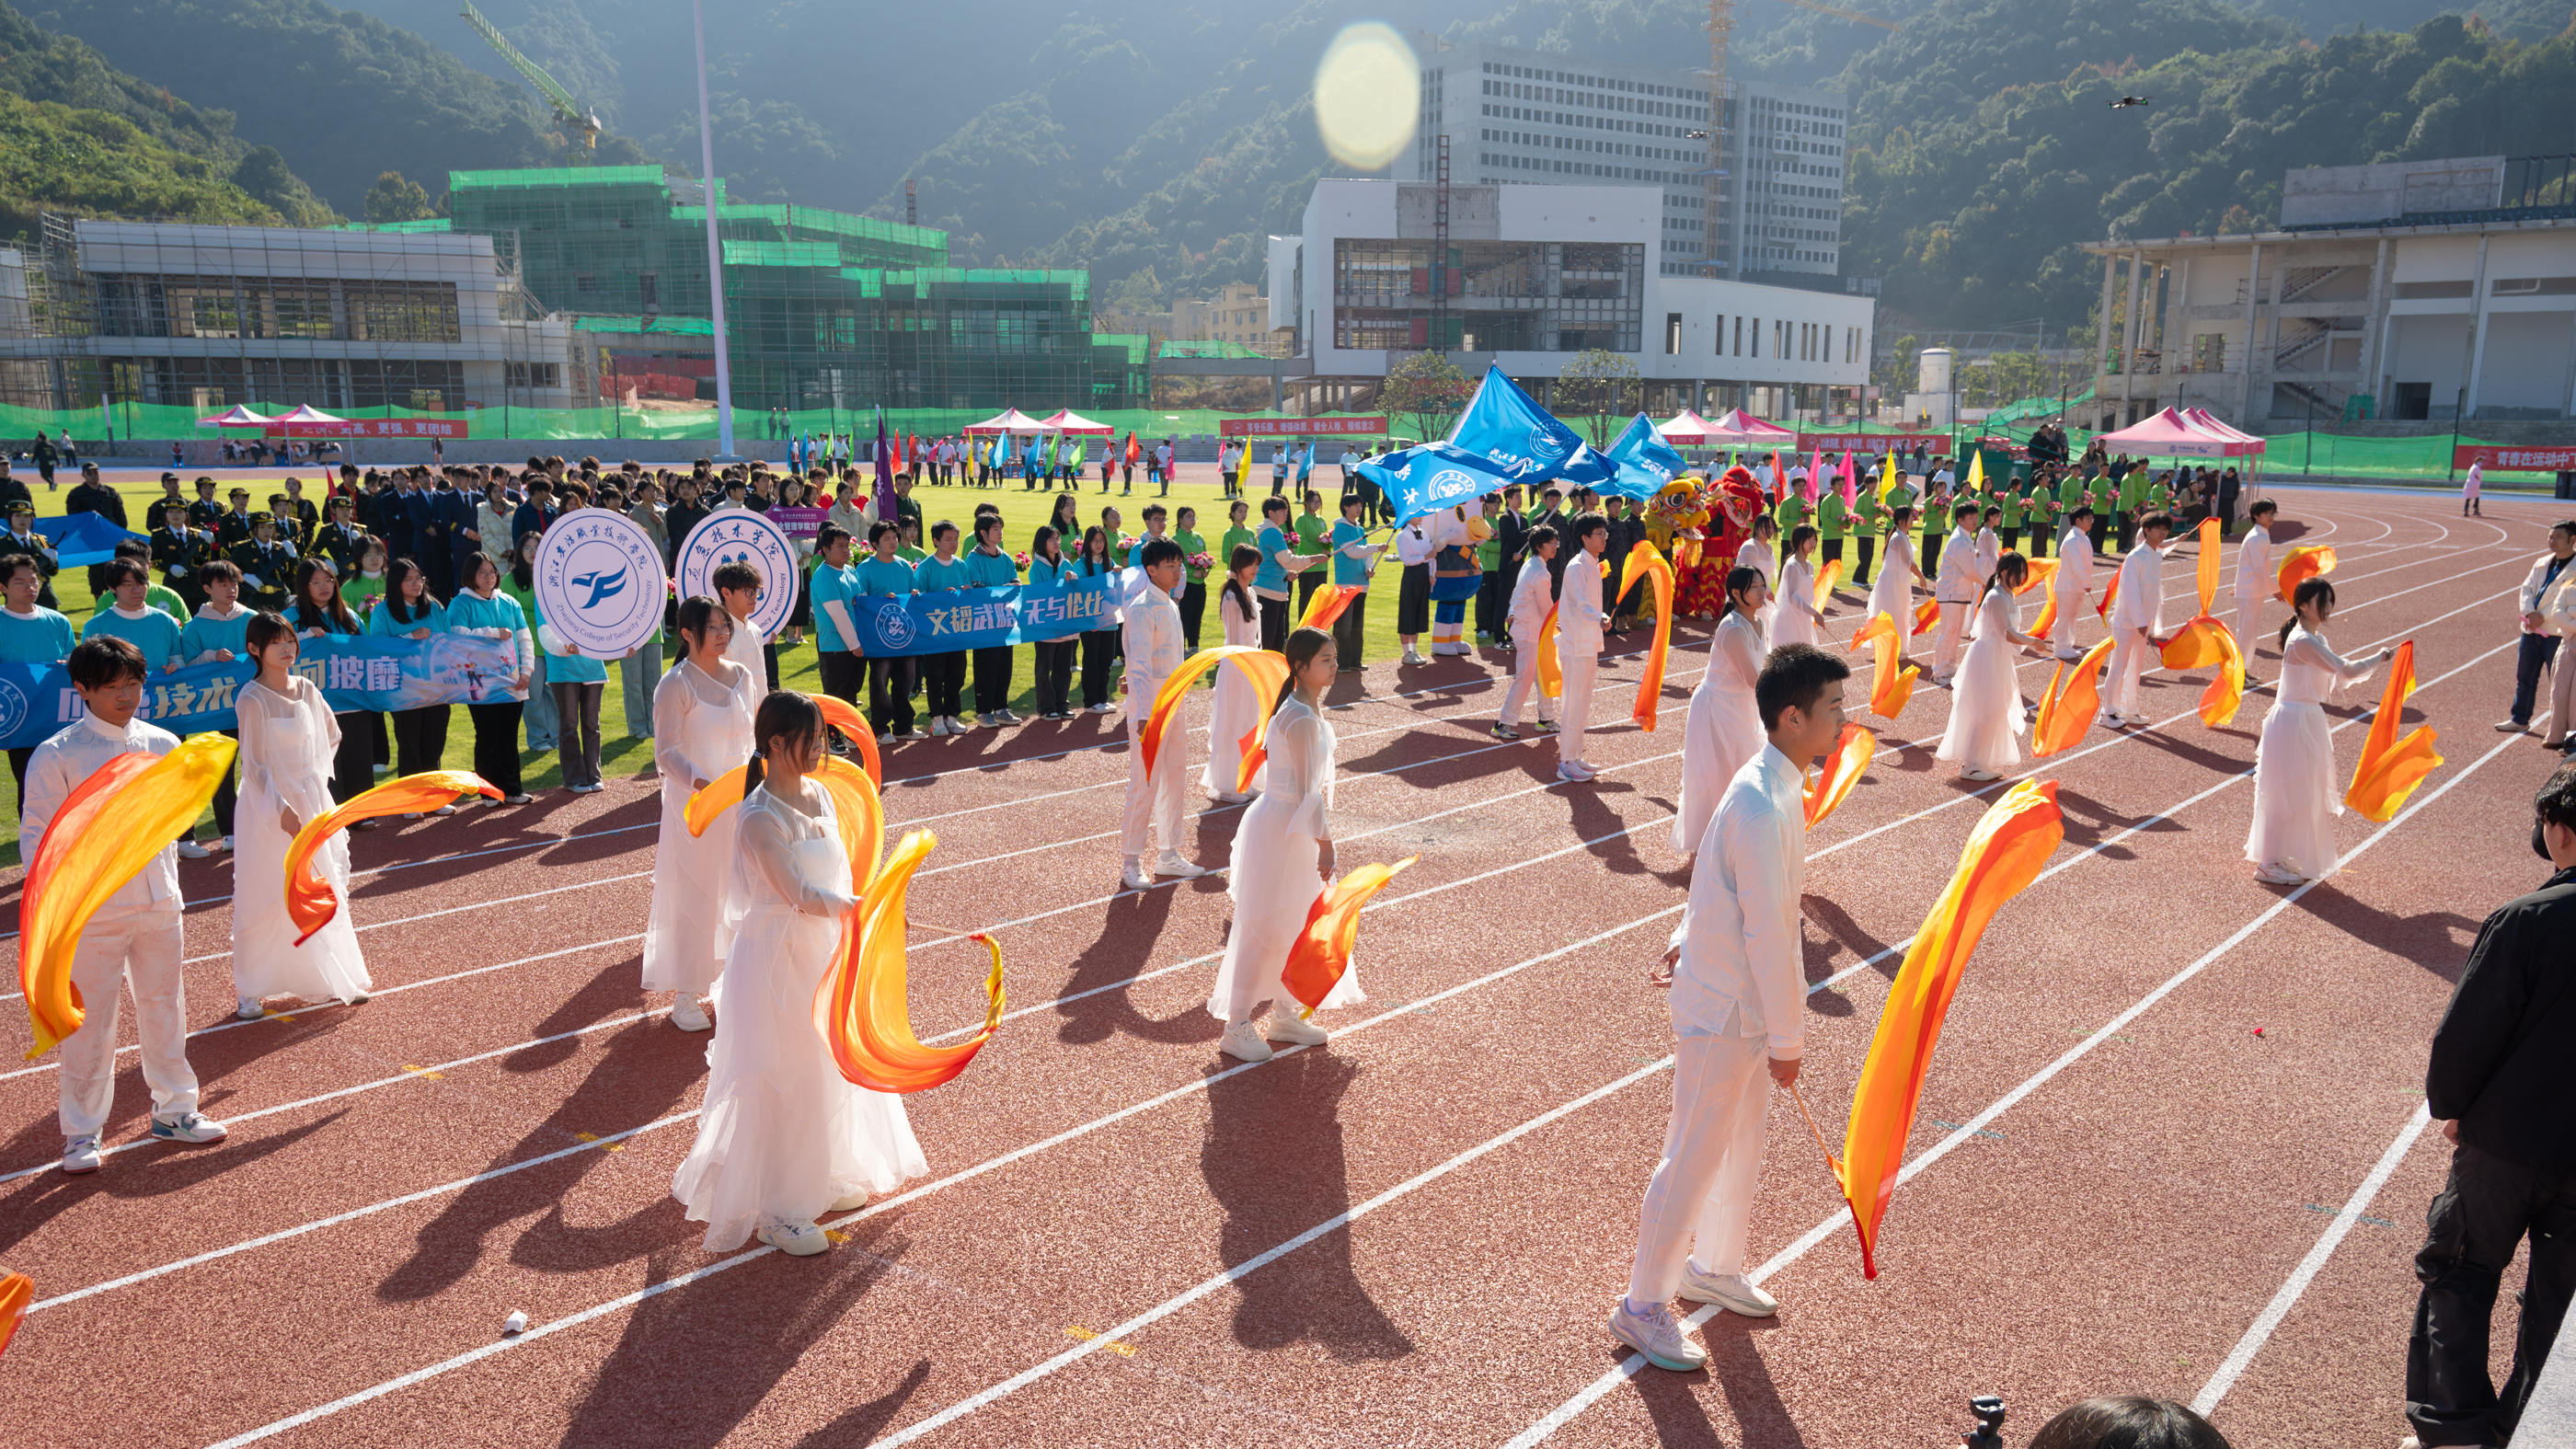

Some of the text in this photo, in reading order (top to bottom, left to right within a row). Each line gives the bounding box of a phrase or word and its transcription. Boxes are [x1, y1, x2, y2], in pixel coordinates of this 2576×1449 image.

[557, 603, 580, 633] Zhejiang
[580, 627, 605, 643] College
[613, 621, 638, 640] Security
[636, 580, 653, 622] Technology
[770, 572, 787, 615] Technology
[926, 601, 1017, 636] 文韬武略
[1024, 590, 1104, 626] 无与伦比
[292, 654, 400, 692] 向披靡
